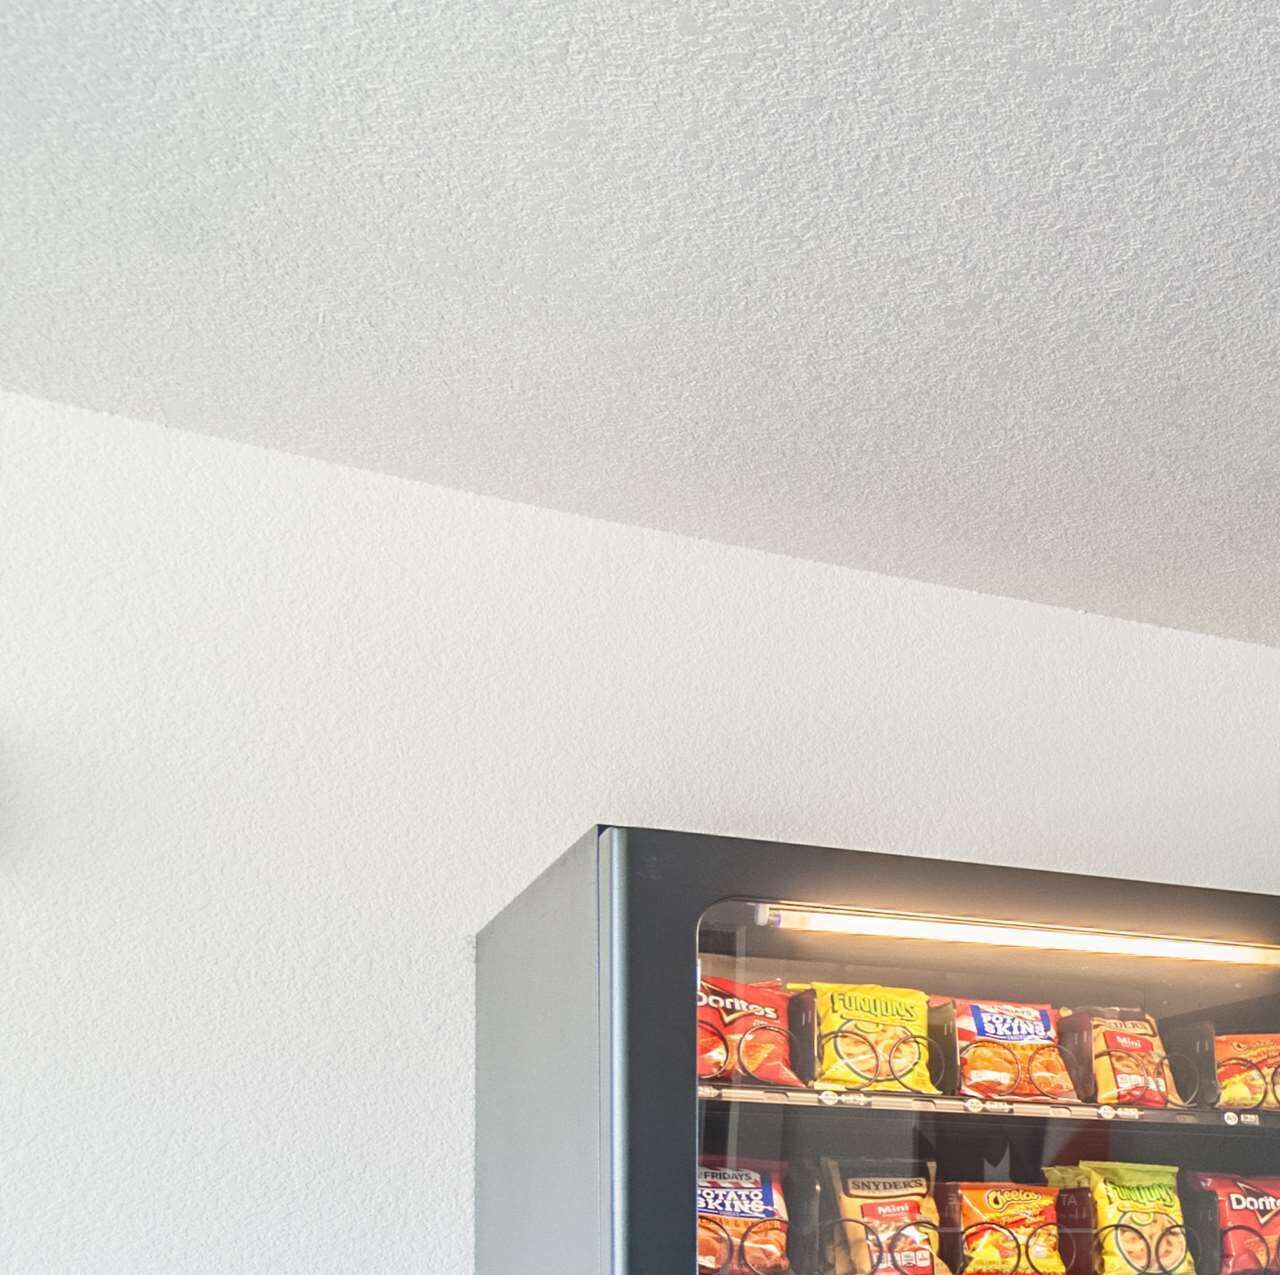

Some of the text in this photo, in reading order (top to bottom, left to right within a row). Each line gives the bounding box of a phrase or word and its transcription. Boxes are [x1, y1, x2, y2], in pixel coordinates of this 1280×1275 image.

[703, 1171, 752, 1181] FRIDAYS
[851, 1179, 923, 1191] SNYDER'S
[877, 1203, 909, 1216] Mini
